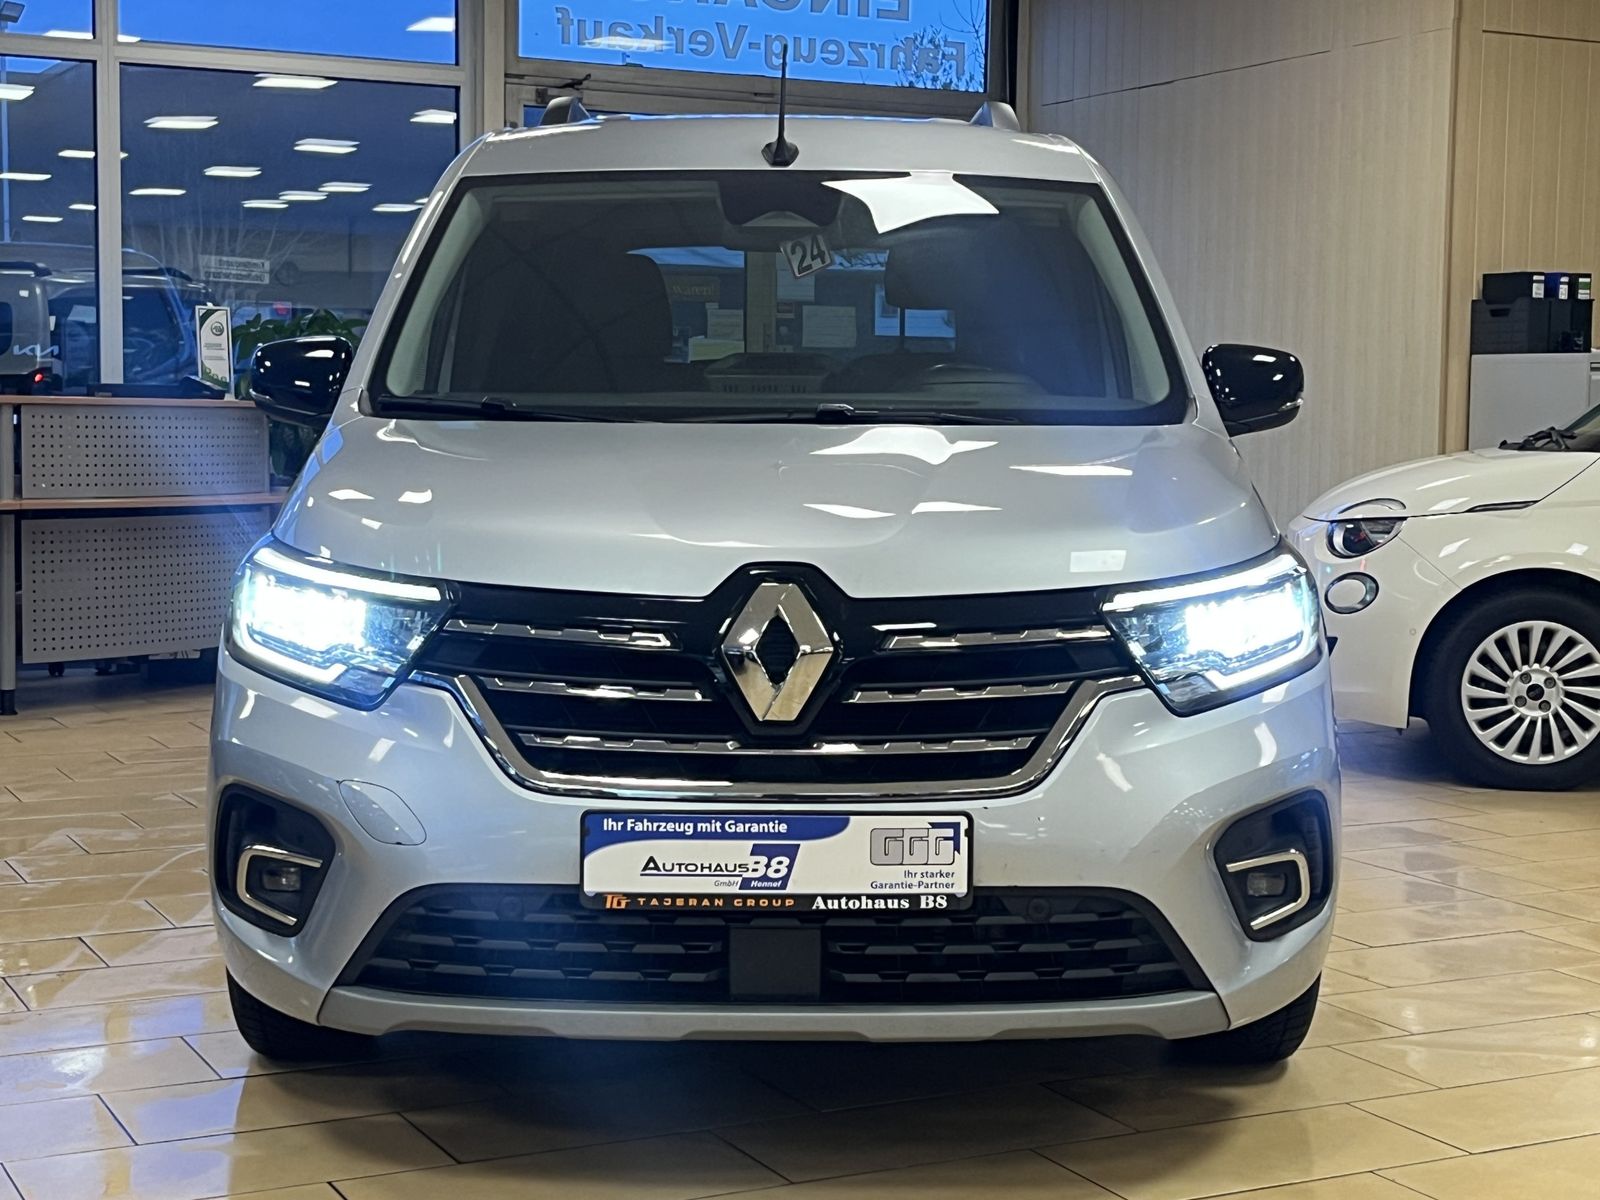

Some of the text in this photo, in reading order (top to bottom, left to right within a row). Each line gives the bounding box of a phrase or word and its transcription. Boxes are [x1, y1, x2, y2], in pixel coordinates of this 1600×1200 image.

[791, 235, 826, 275] 24
[603, 818, 788, 835] Ihr Fahrzeug mit Garantie
[904, 870, 955, 878] Ihr starker
[751, 880, 782, 888] Hennef
[870, 881, 955, 889] Garantie-Partner
[637, 898, 724, 906] TAJERAN
[734, 898, 795, 907] GROUP
[812, 895, 948, 910] Autohaus B8
